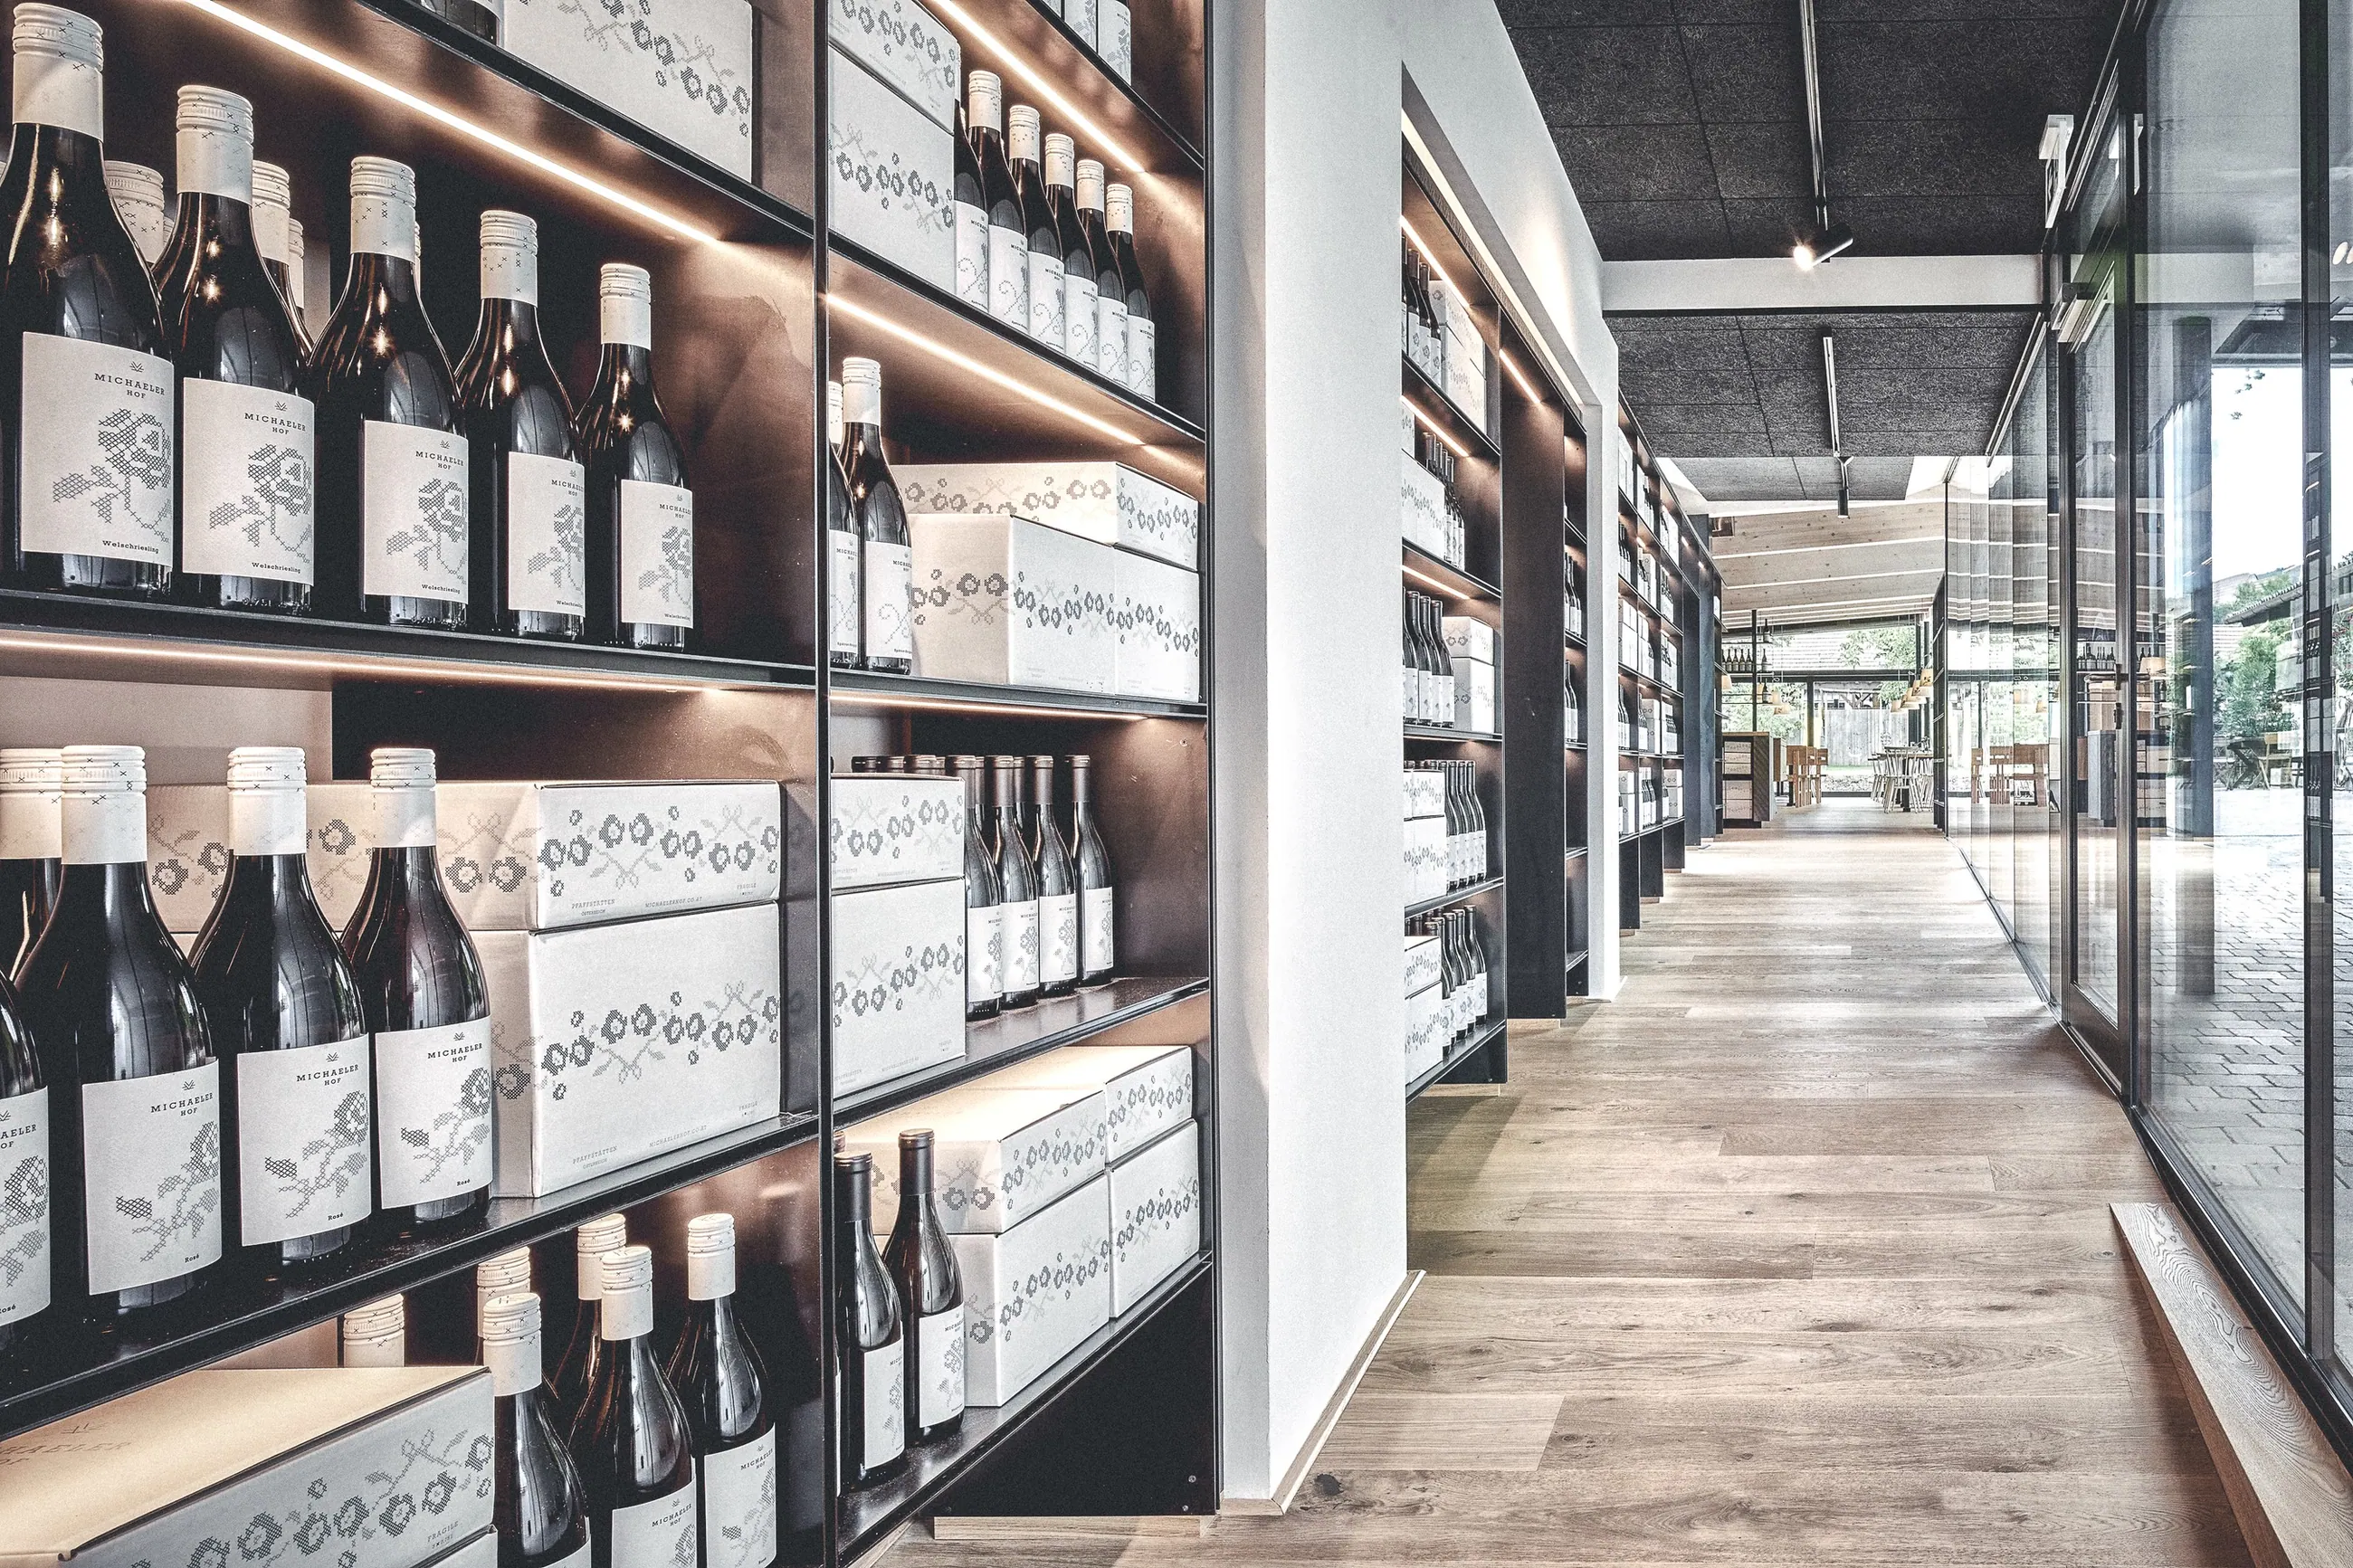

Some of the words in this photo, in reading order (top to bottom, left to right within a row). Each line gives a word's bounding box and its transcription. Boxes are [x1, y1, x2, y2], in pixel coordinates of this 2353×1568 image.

[94, 373, 165, 395] MICHAELER
[127, 389, 146, 399] HOF
[244, 413, 306, 432] MICHAELER
[272, 427, 290, 435] HOF
[102, 540, 159, 554] Welschriesling
[252, 562, 301, 575] Welschriesling
[421, 584, 461, 594] Welschriesling
[427, 1042, 482, 1060] MICHAELER
[296, 1064, 359, 1082] MICHAELER
[324, 1077, 341, 1086] HOF
[150, 1092, 214, 1114] MICHAELER
[180, 1107, 198, 1117] HOF
[328, 1212, 344, 1221] Rosé
[185, 1252, 200, 1263] Rosé
[427, 1520, 459, 1543] FRAGILE
